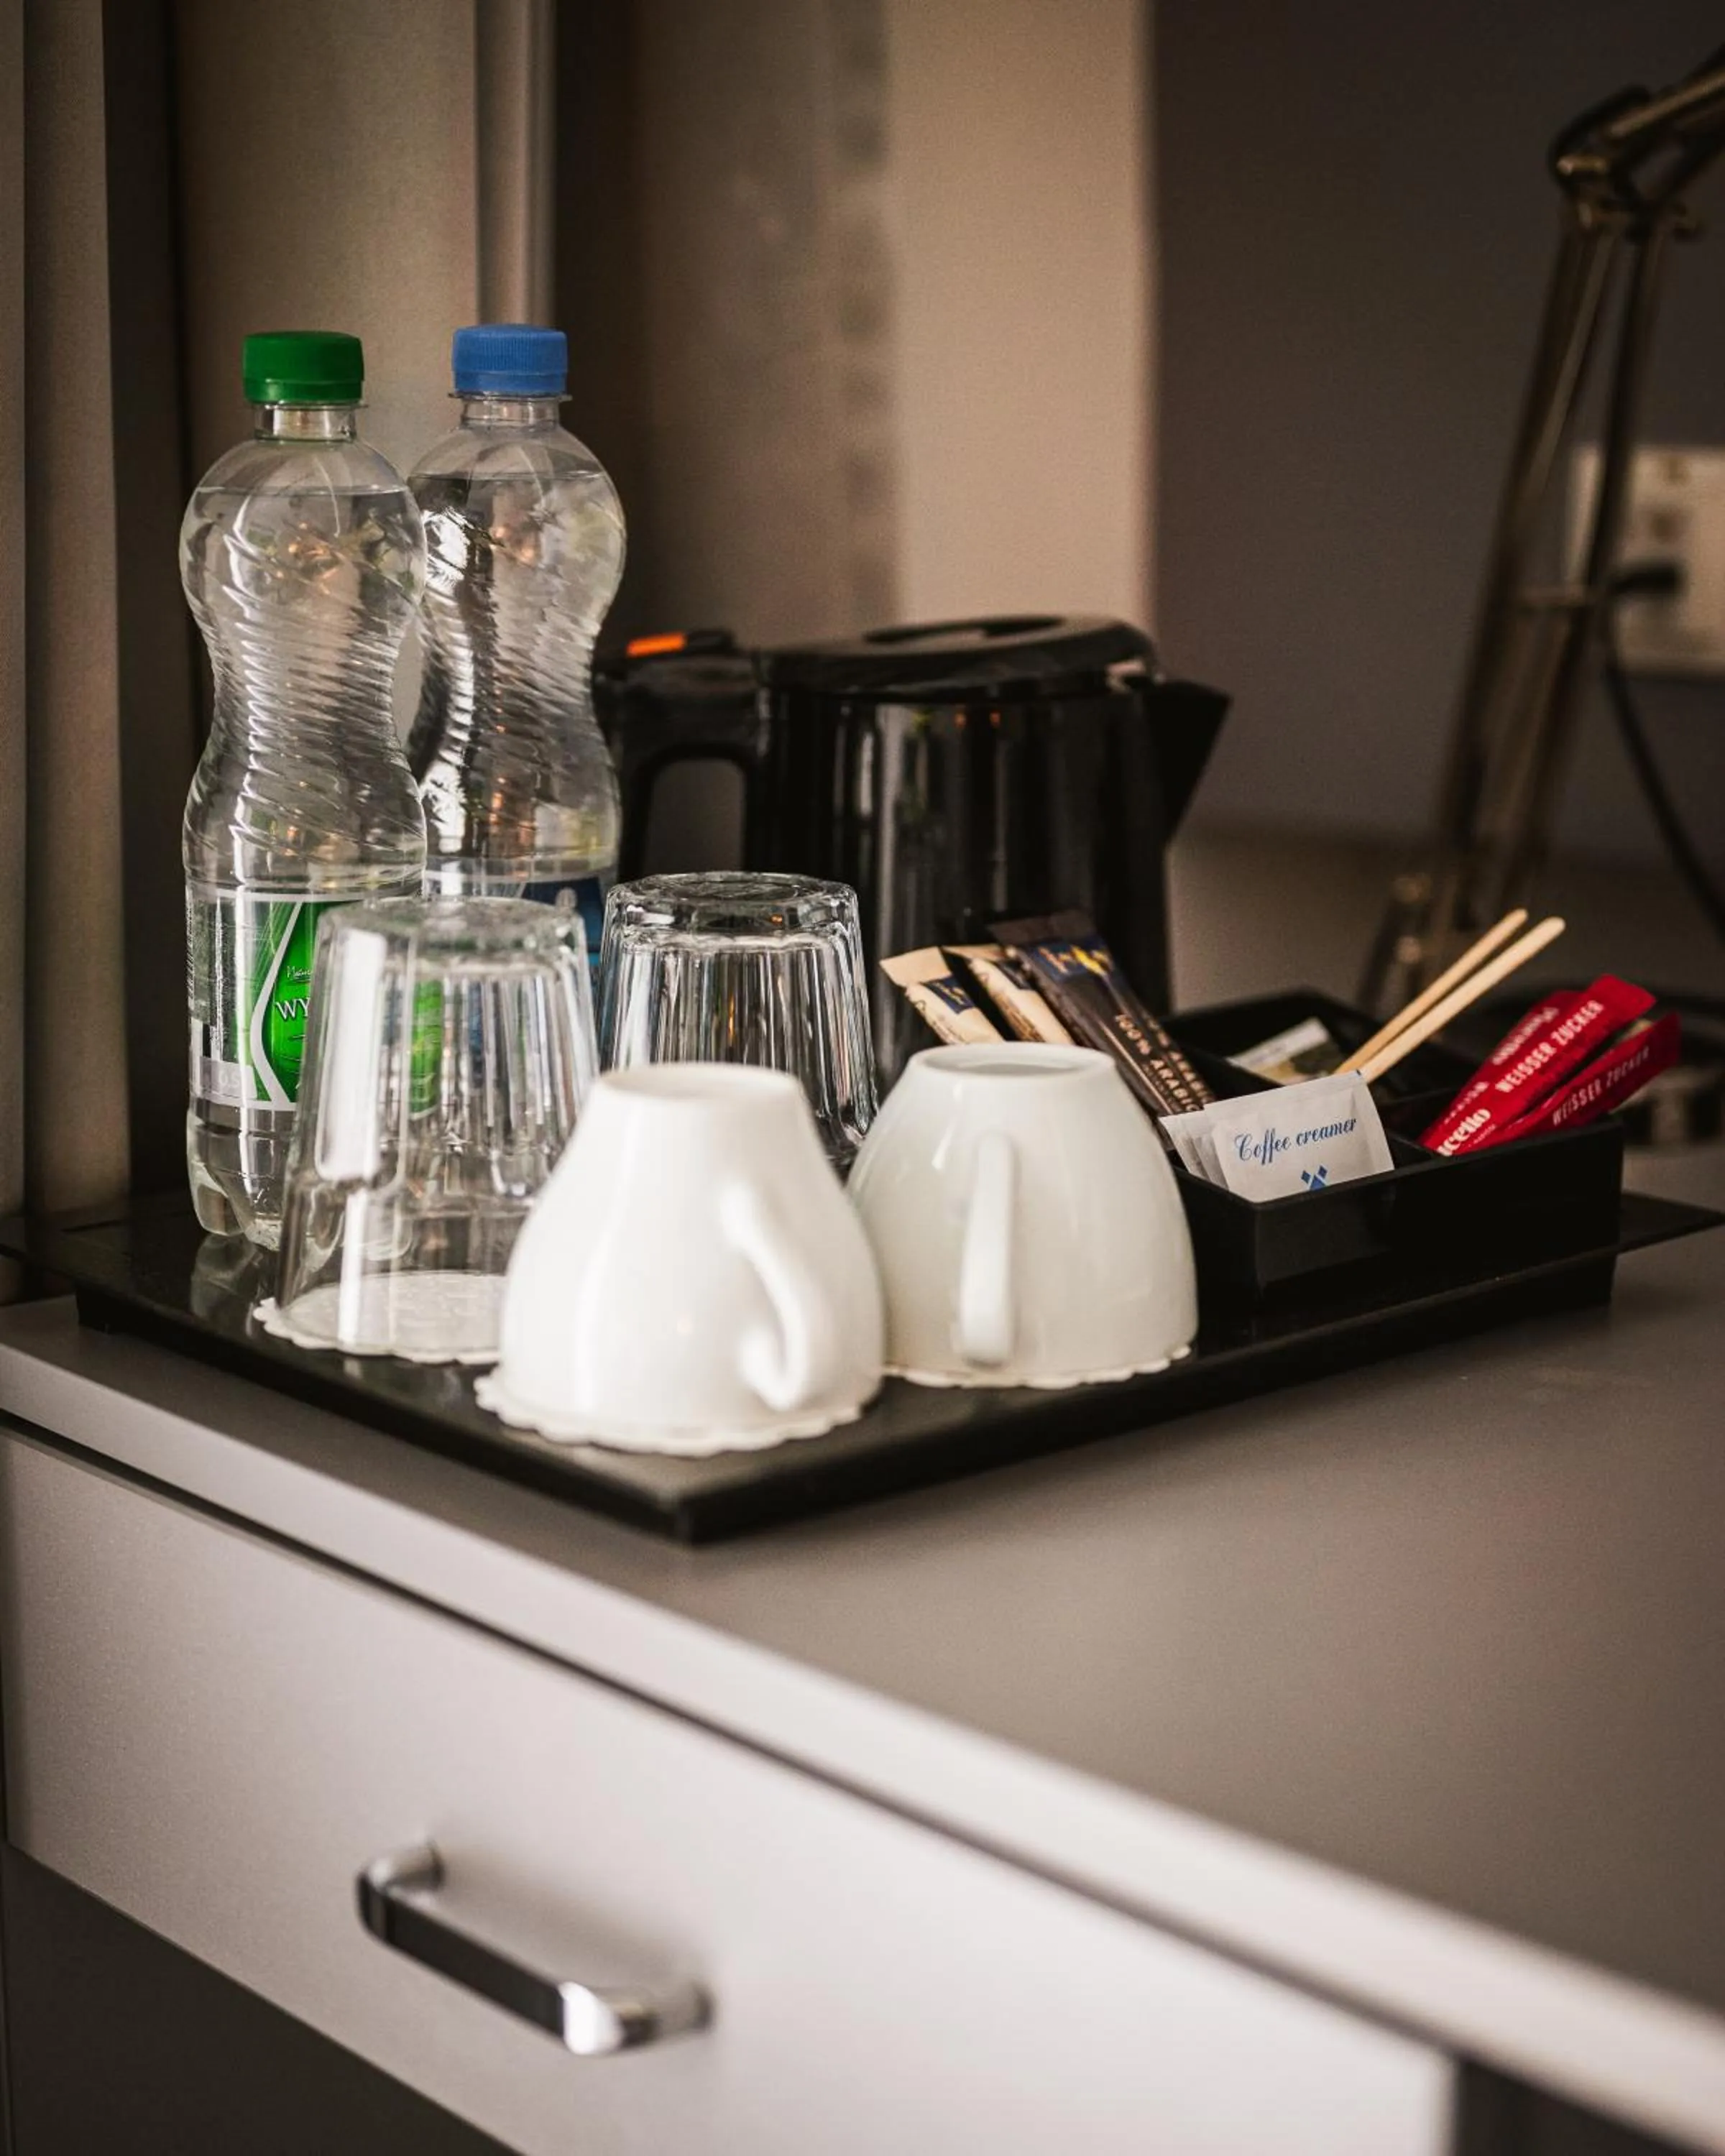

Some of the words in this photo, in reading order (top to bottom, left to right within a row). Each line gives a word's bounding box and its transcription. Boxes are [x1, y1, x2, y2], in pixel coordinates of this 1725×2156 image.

[275, 997, 310, 1020] WY
[1150, 1059, 1201, 1112] ARABIC
[1495, 1042, 1557, 1092] WEISSER
[1234, 1128, 1292, 1165] Coffee
[1296, 1118, 1357, 1146] creamer
